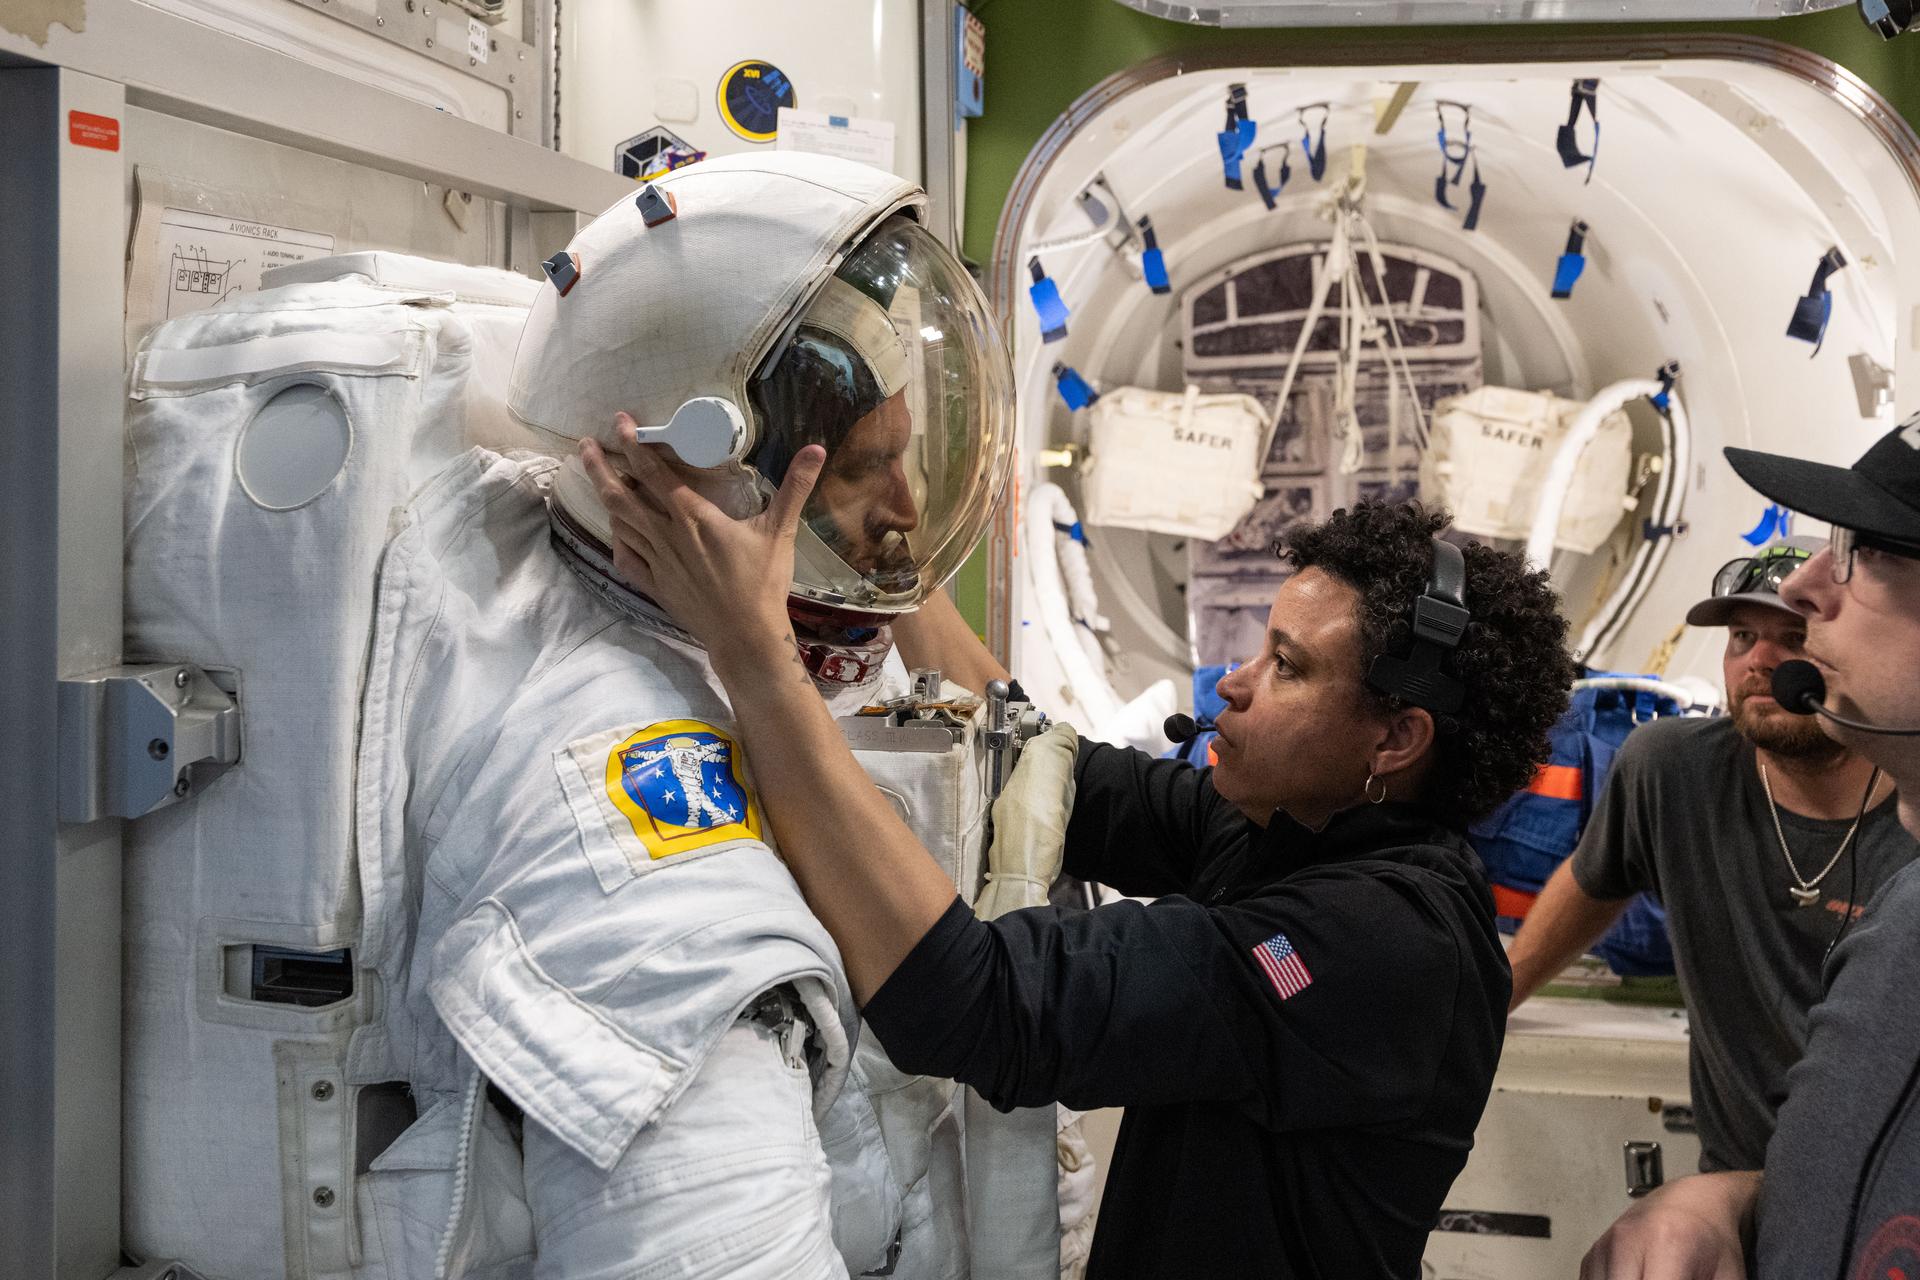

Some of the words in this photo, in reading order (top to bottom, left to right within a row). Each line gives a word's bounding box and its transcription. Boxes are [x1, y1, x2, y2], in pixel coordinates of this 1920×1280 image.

[229, 223, 260, 236] AVIONICS
[262, 227, 279, 239] RACK
[1174, 428, 1232, 450] SAFER
[1482, 424, 1543, 449] SAFER
